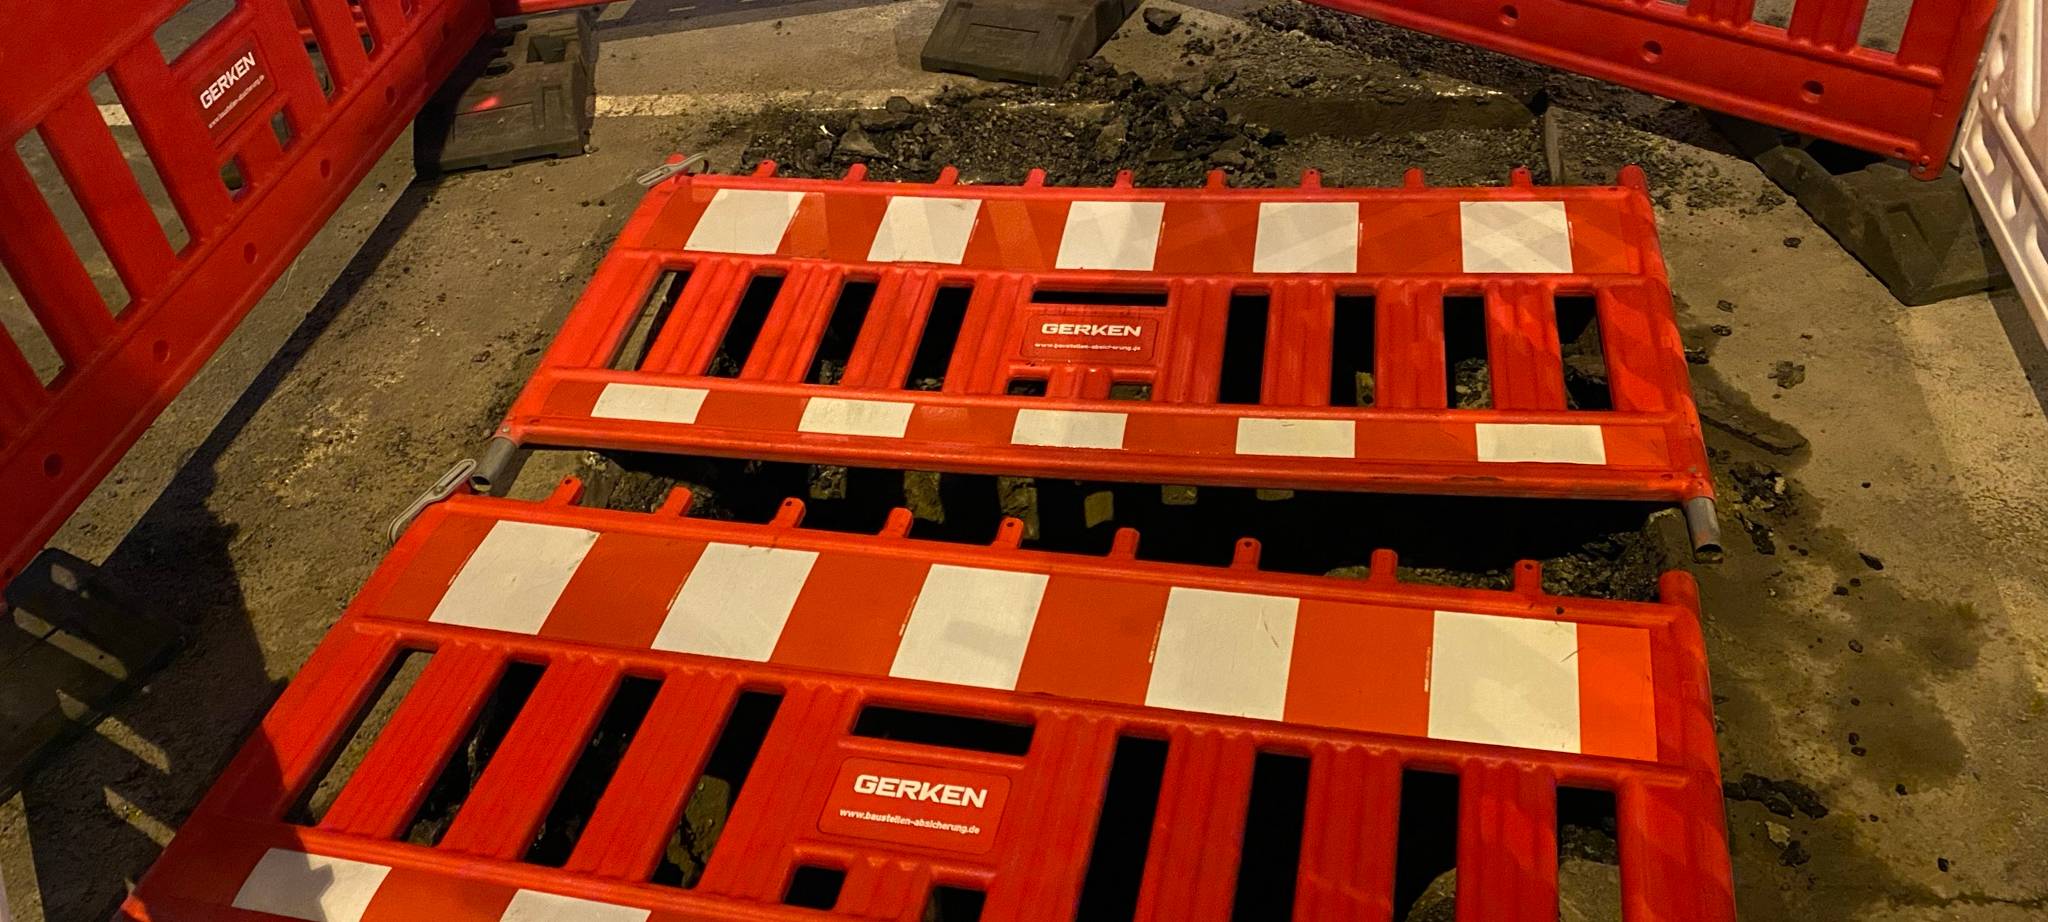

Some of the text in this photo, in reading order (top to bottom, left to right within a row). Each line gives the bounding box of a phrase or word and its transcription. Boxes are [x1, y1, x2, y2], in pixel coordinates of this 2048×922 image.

[200, 51, 256, 109] GERKEN
[1041, 323, 1142, 337] GERKEN
[853, 773, 988, 809] GERKEN
[839, 808, 981, 834] www.baustellen-absicherung.de
